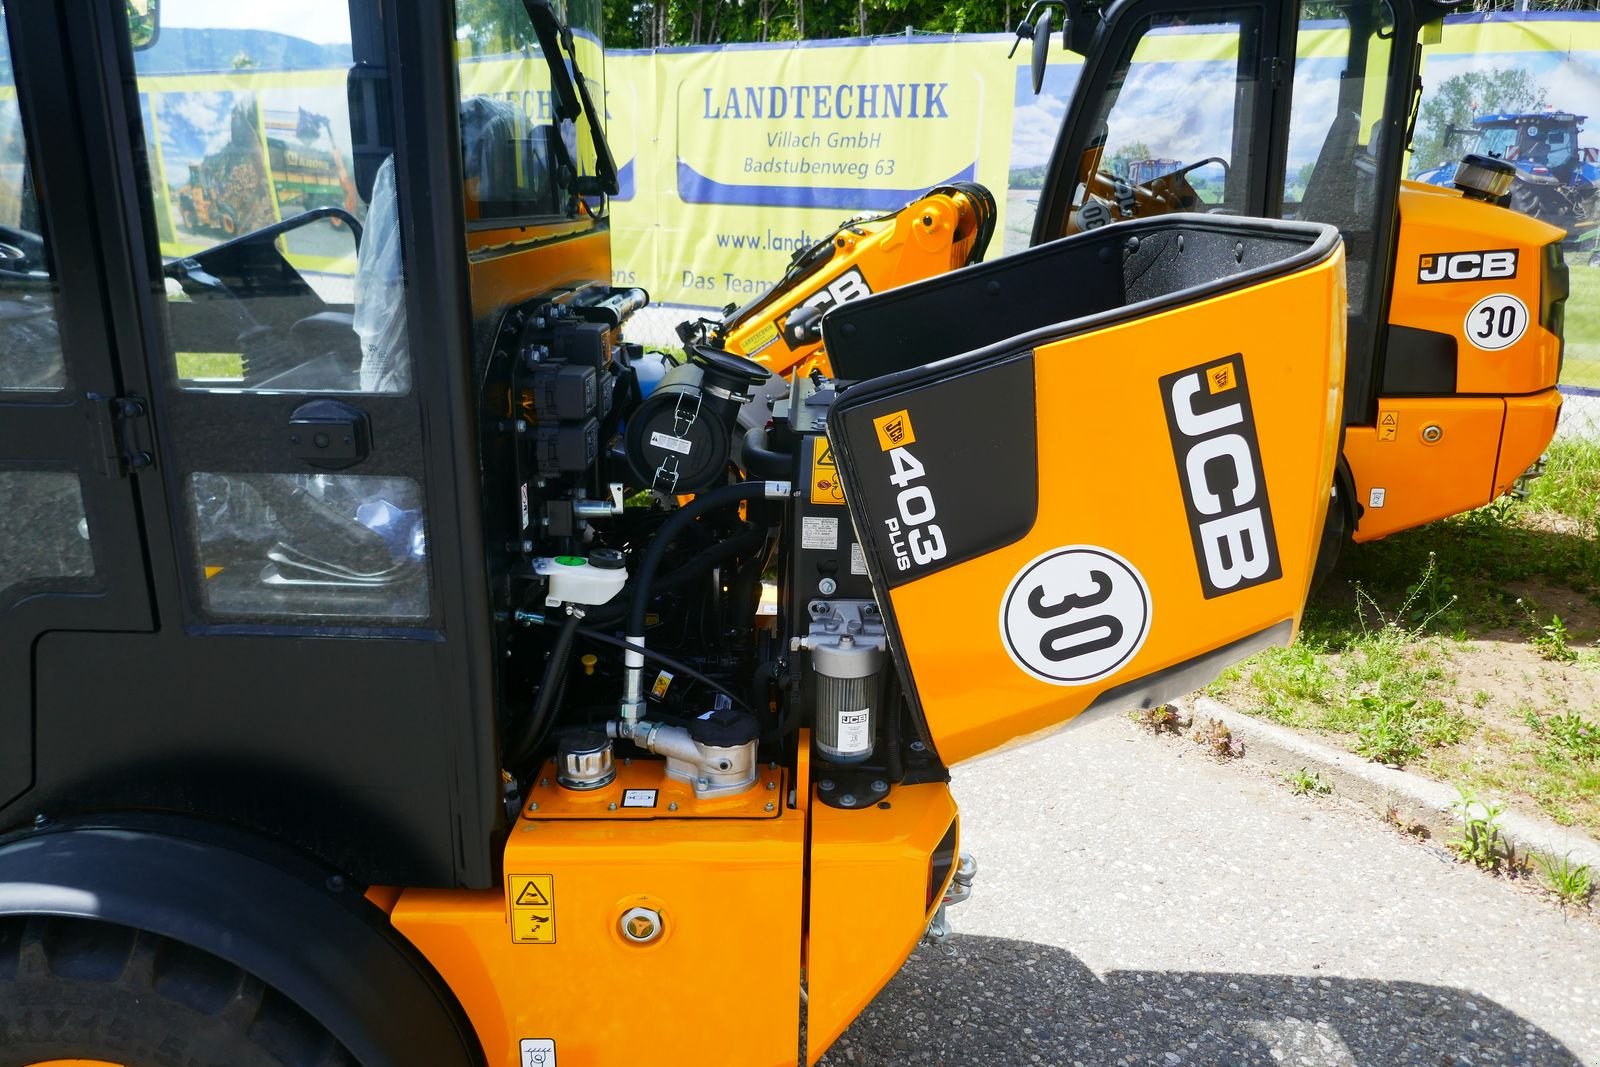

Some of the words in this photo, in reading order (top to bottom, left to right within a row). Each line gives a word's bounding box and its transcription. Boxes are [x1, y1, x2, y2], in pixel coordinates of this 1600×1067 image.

[703, 83, 949, 119] LANDTECHNIK
[767, 131, 821, 149] Villach
[827, 131, 882, 149] GmbH
[744, 157, 869, 180] Badstubenweg
[875, 159, 896, 176] 63
[682, 270, 715, 290] Das
[1419, 251, 1516, 282] JCB
[1476, 305, 1516, 339] 30
[885, 420, 903, 442] JCB
[1171, 372, 1271, 590] JCB
[889, 446, 948, 566] 403
[884, 517, 911, 571] PLUS
[1026, 569, 1124, 663] 30
[841, 714, 867, 724] JCB
